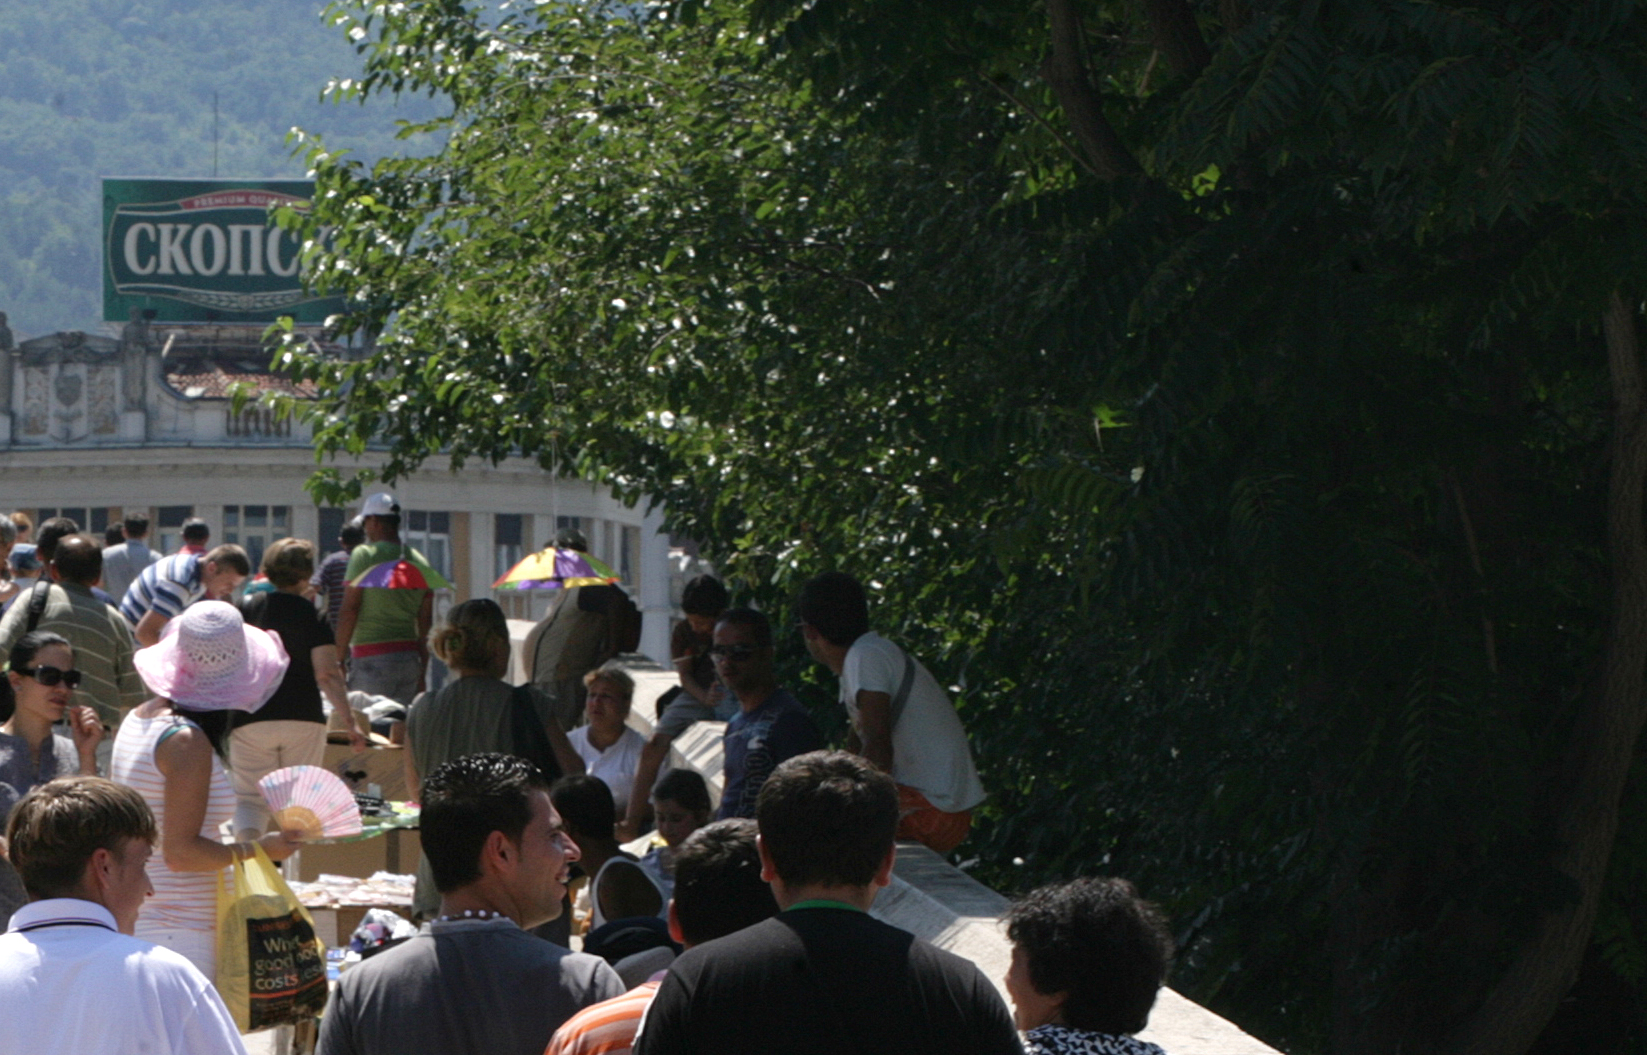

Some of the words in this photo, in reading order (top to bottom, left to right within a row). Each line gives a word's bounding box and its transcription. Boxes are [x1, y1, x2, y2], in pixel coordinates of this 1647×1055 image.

[194, 196, 245, 206] PREMIUM
[255, 955, 293, 976] good
[256, 974, 297, 990] costs
